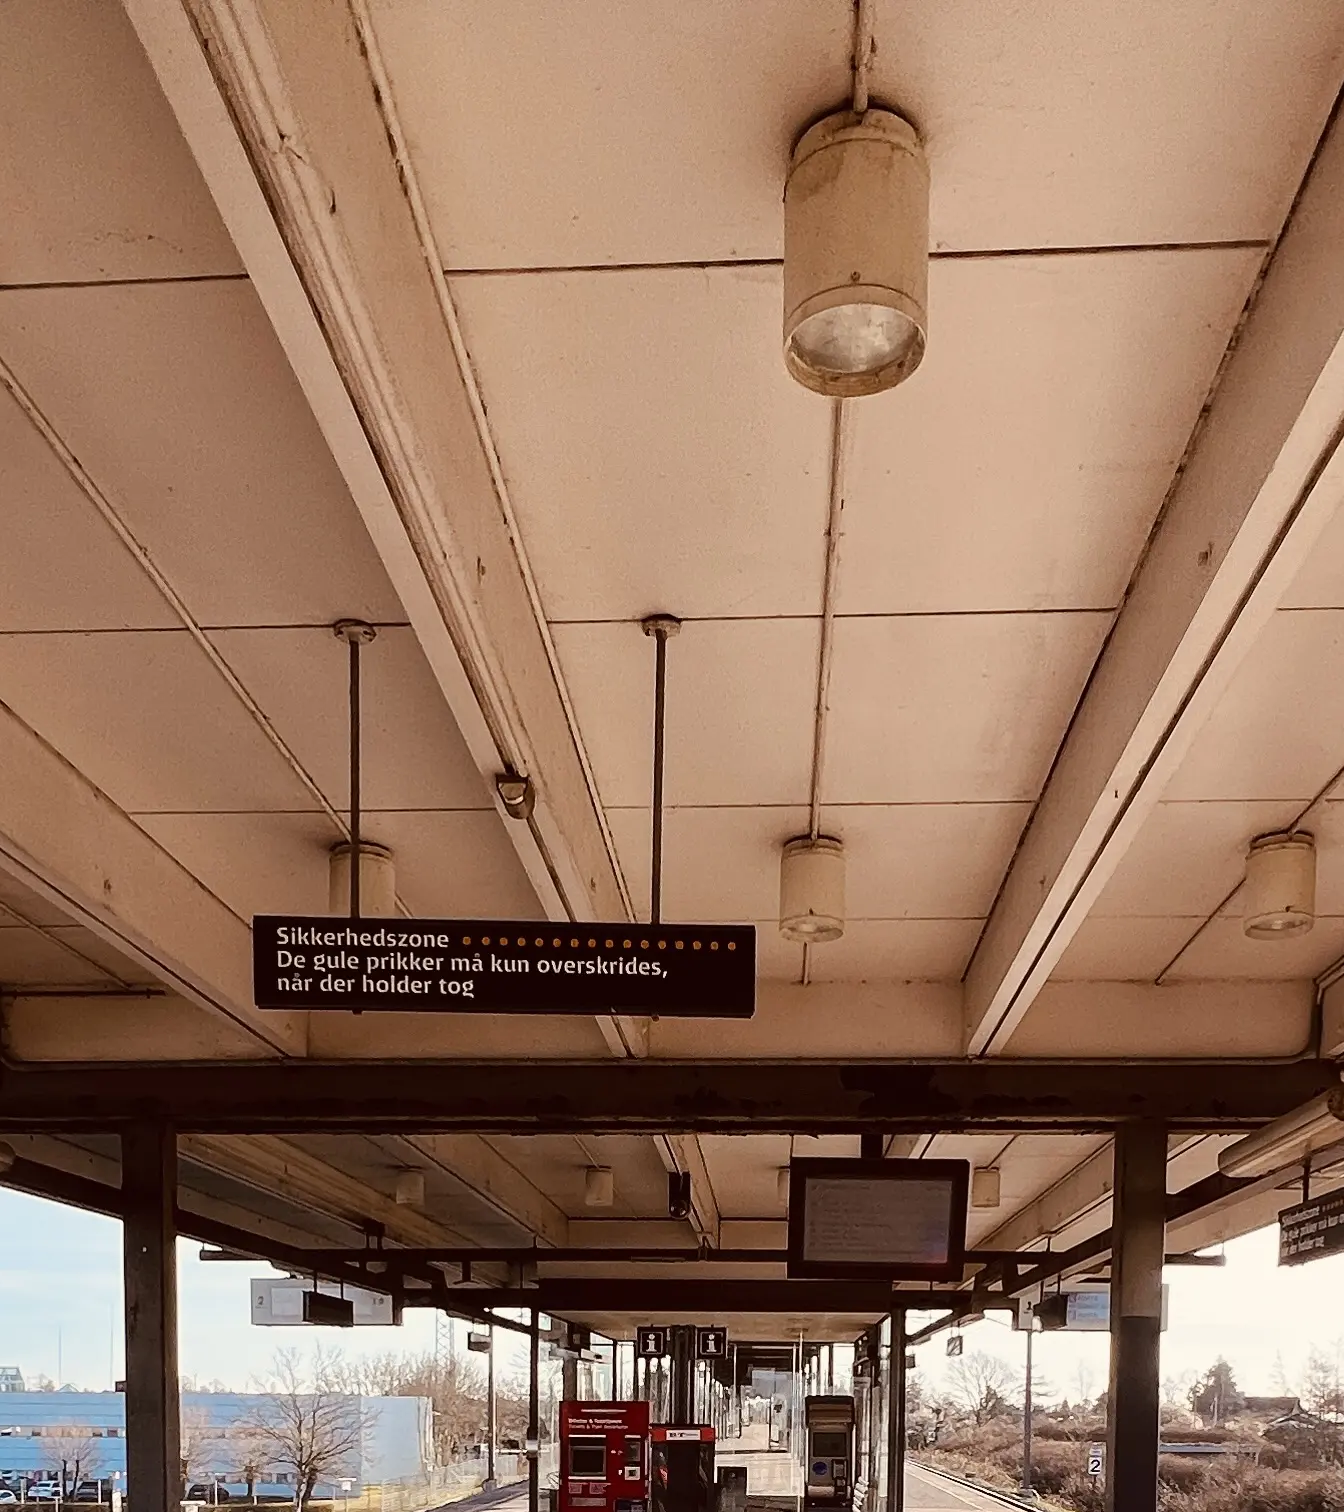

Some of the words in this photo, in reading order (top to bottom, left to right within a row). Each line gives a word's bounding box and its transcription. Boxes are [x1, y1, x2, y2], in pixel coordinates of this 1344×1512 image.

[276, 926, 449, 948] Sikkerhedszone
[277, 950, 306, 969] De
[313, 951, 359, 973] gule
[367, 952, 445, 974] prikker
[450, 952, 484, 972] må
[491, 953, 530, 973] kun
[536, 956, 668, 979] overskrides,
[277, 972, 313, 992] når
[319, 973, 356, 993] der
[362, 974, 432, 994] holder
[438, 978, 475, 999] tog
[1090, 1459, 1101, 1473] 2
